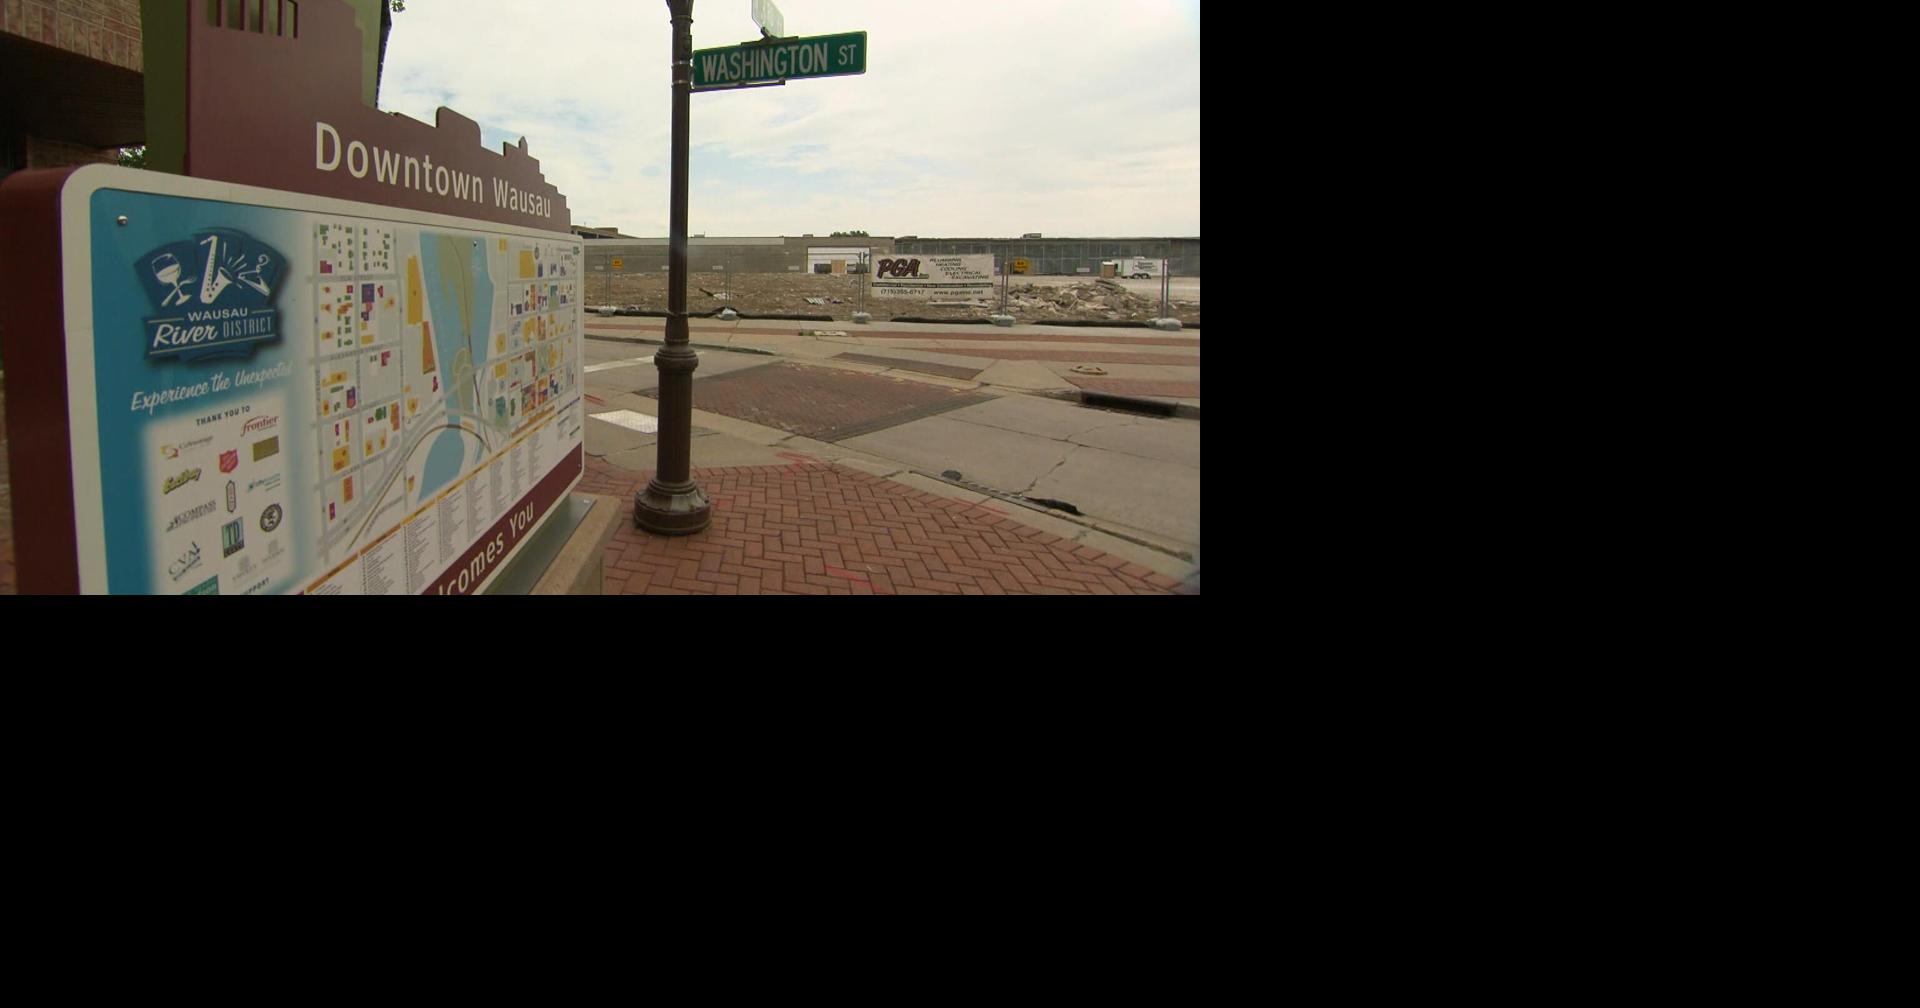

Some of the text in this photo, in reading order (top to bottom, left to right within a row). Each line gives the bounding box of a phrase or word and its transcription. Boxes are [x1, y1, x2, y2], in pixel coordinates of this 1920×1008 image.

[702, 43, 856, 82] WASHINGTON ST
[315, 121, 551, 218] Downtown Wausau
[876, 258, 921, 279] PGA
[187, 308, 249, 322] WAUSAU
[153, 317, 272, 348] River DISTRICT
[131, 382, 209, 415] Experience
[211, 372, 232, 392] the
[196, 405, 250, 426] THANK YOU TO
[509, 502, 534, 538] You
